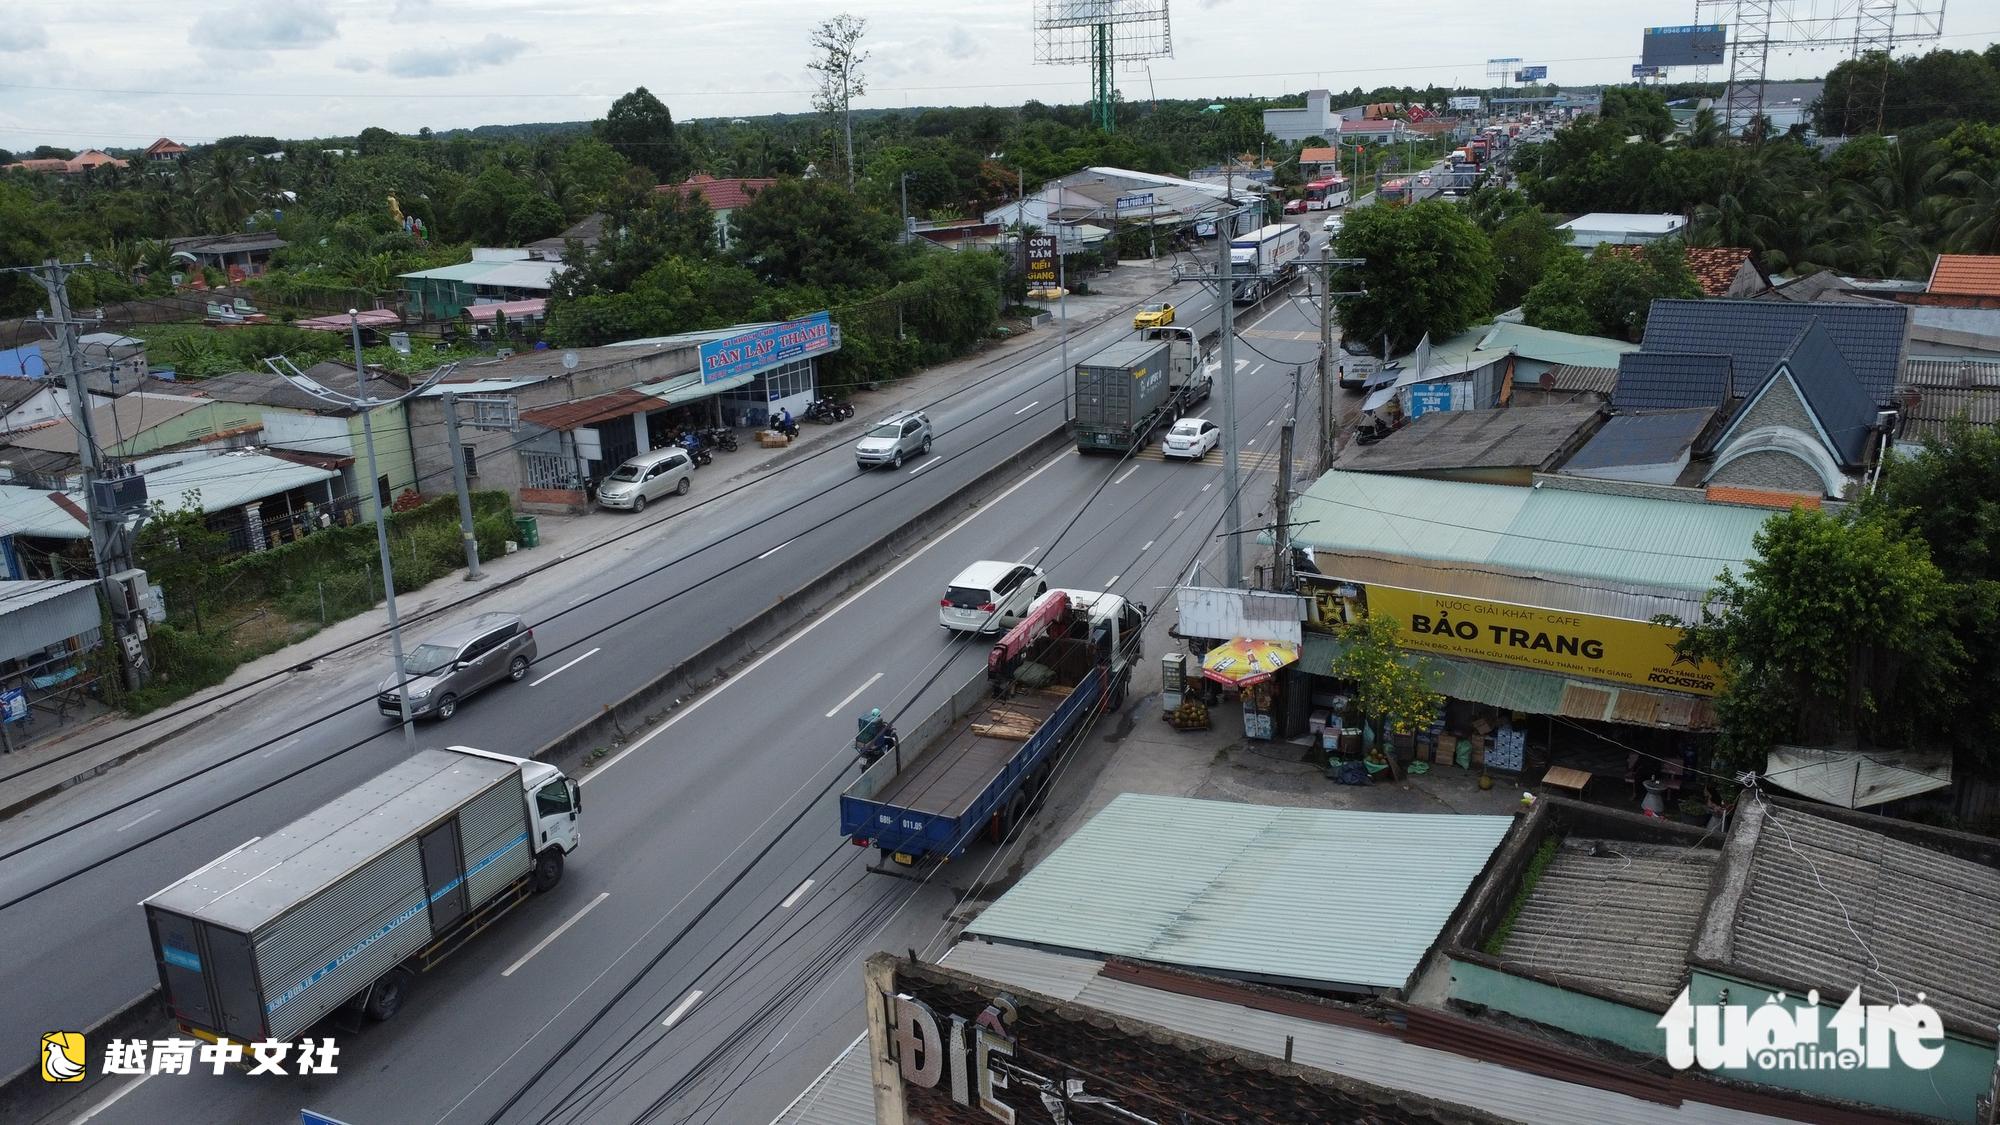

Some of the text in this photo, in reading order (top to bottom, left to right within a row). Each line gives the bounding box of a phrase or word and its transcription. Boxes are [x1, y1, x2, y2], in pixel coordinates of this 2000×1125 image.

[706, 348, 741, 369] TÂN
[744, 338, 776, 360] LẬP
[778, 322, 828, 348] THÀNH
[1436, 599, 1581, 627] NƯỚC GIẢI KHÁT CAFE
[1411, 610, 1604, 659] BẢO TRANG
[1608, 670, 1633, 679] GIANG
[1648, 673, 1716, 691] ROCKSTAR
